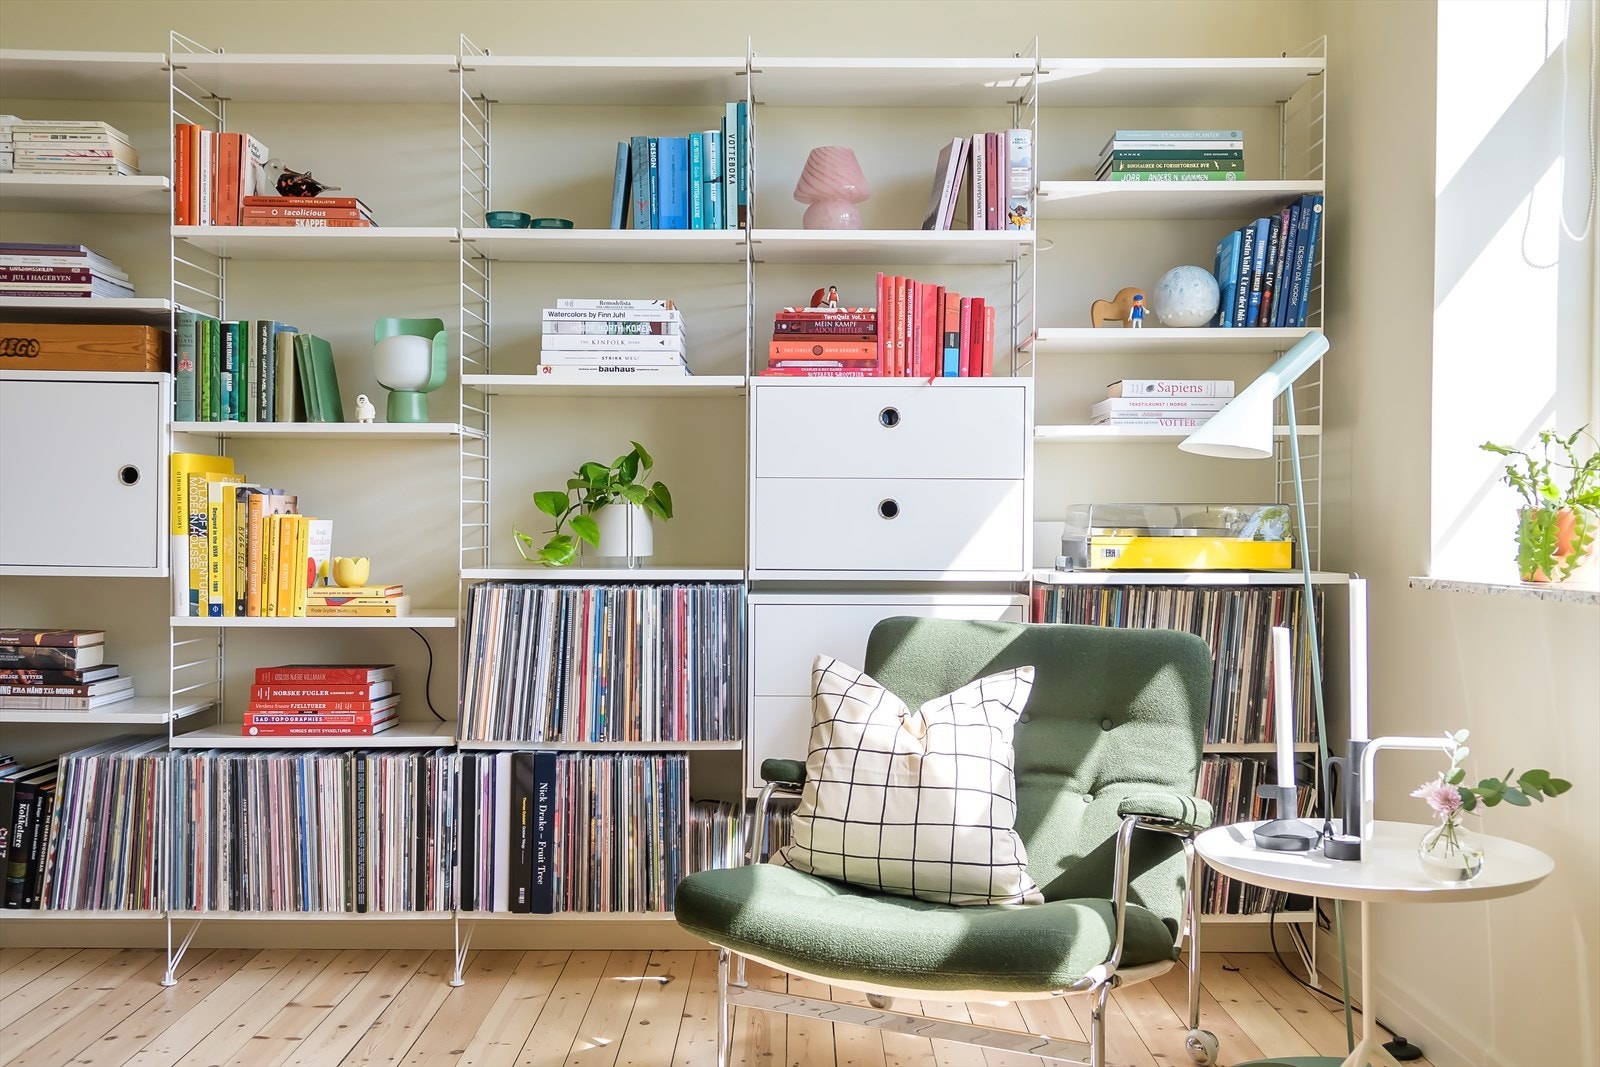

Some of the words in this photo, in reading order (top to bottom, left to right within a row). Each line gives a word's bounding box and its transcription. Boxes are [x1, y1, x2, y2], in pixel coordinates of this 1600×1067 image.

[295, 219, 327, 227] SKAPPEL
[1244, 229, 1254, 256] Kristin
[1242, 256, 1251, 274] Valla
[1296, 246, 1305, 270] DESIGN
[1240, 286, 1246, 296] av
[1241, 277, 1249, 286] Ut
[1238, 296, 1247, 308] det
[1291, 282, 1299, 306] NORSK
[1237, 309, 1246, 321] blå
[1157, 382, 1203, 396] Sapiens
[190, 477, 198, 524] MODERN
[199, 477, 207, 510] ATLAS
[199, 512, 207, 527] OF
[190, 528, 198, 570] HOUSES
[1106, 549, 1115, 557] ERA
[199, 529, 208, 603] MID-CENTURY
[252, 562, 257, 571] om
[539, 782, 548, 802] Nick
[538, 805, 547, 831] Drake
[39, 842, 48, 872] WOODSMAN
[538, 841, 546, 863] Fruit
[537, 865, 545, 885] Tree
